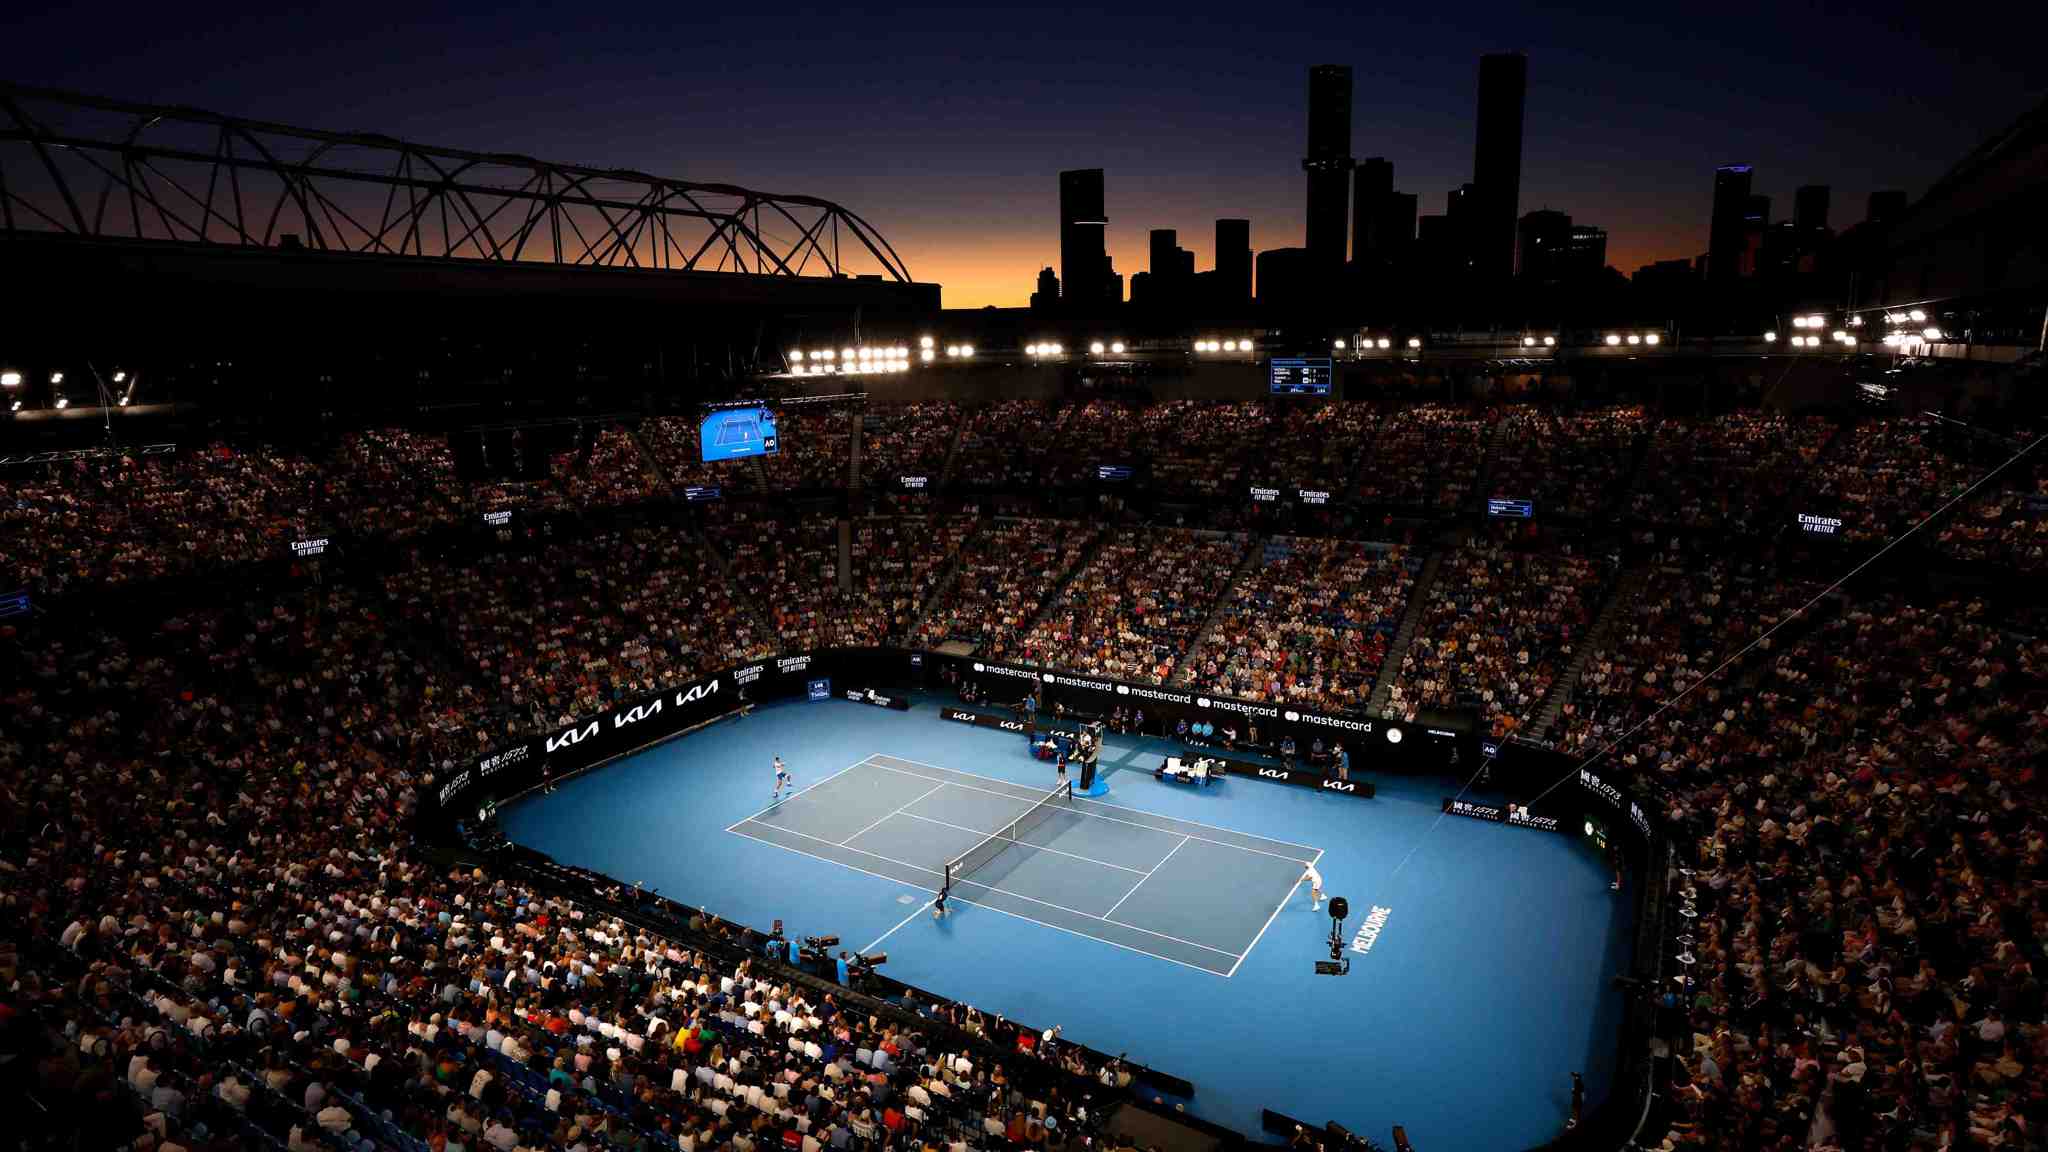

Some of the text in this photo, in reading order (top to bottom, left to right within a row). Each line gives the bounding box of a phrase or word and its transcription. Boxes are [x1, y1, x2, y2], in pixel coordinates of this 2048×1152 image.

[1250, 486, 1280, 496] Emirates
[1299, 489, 1330, 499] Emirates
[1798, 513, 1842, 527] Emirates
[291, 539, 329, 551] Emirates
[777, 655, 811, 668] Emirates
[734, 664, 764, 680] Emirates
[986, 665, 1038, 681] mastercard
[1056, 675, 1112, 692] mastercard
[676, 679, 719, 706] KIA
[1131, 686, 1191, 705] mastercard
[615, 699, 662, 728] KIA
[953, 712, 975, 721] KIA
[1213, 699, 1278, 718] mastercard
[1000, 720, 1023, 731] KIA
[1302, 712, 1372, 733] mastercard
[546, 721, 599, 753] KIA
[1259, 767, 1288, 780] KIA
[1323, 779, 1354, 792] KIA
[1350, 904, 1392, 954] MELBOURNE
